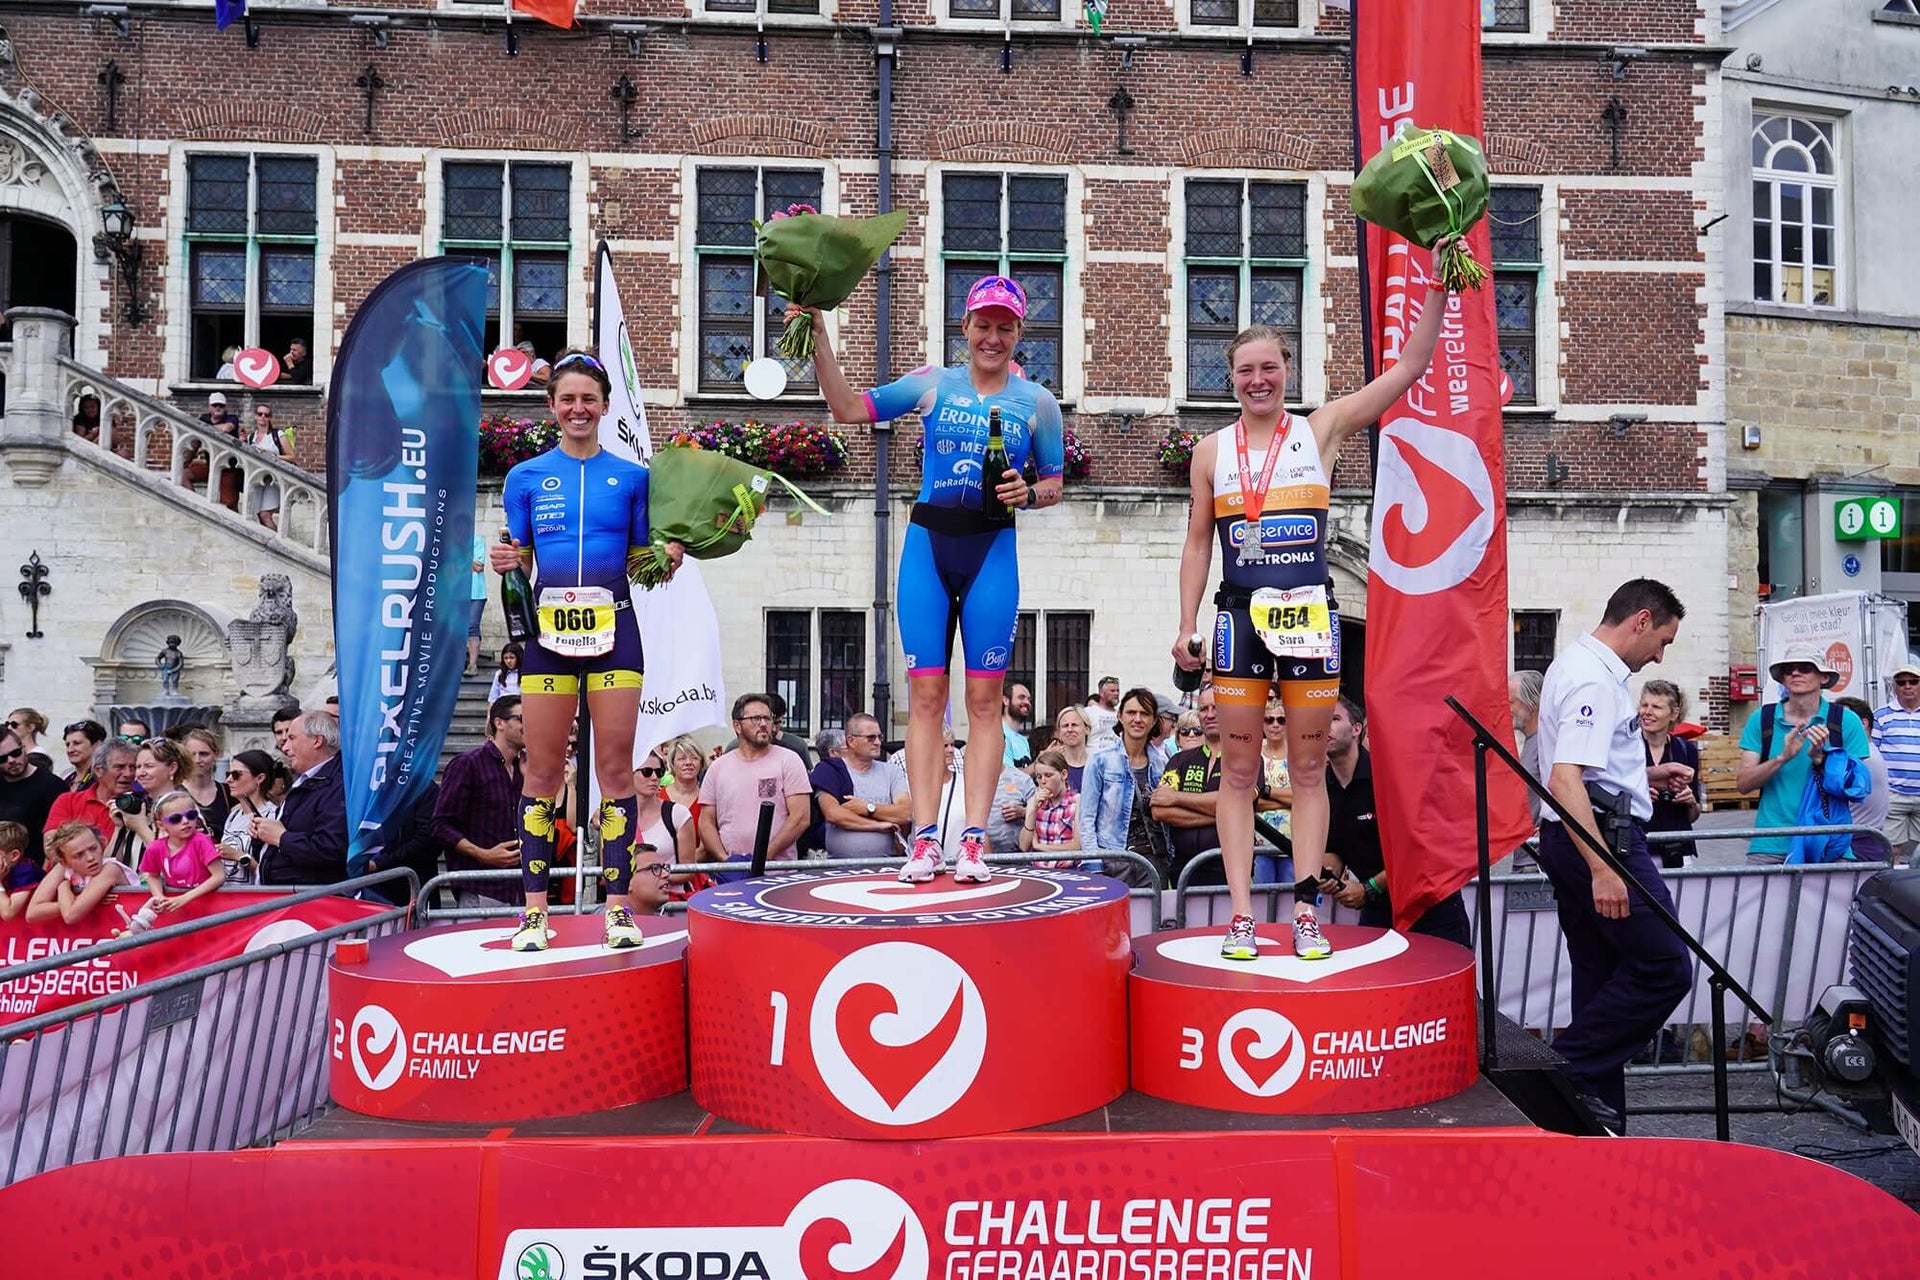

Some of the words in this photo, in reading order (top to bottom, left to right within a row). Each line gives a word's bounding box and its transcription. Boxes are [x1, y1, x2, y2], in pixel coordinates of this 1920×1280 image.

[935, 425, 1020, 447] ALKOHOLREI
[938, 407, 1022, 439] ERDINER
[423, 488, 447, 622] PRODUCTIONS
[554, 608, 596, 631] 060
[1268, 606, 1309, 629] 054
[1278, 635, 1305, 646] Sara
[417, 631, 433, 688] MOVIE
[639, 683, 718, 715] .skoda.b
[397, 695, 425, 786] CREATIVE
[745, 872, 820, 887] THE
[824, 864, 1092, 883] CHAONSHIP
[915, 896, 1101, 924] SLOVAKIA
[0, 994, 39, 1014] hlon!
[334, 1017, 345, 1061] 2
[412, 1027, 567, 1055] CHALLENGE
[769, 990, 789, 1067] 1
[1312, 1017, 1447, 1055] CHALLENGE
[1179, 1026, 1205, 1070] 3
[408, 1058, 481, 1080] FAMILY
[1309, 1056, 1384, 1081] FAMILY
[944, 1198, 1272, 1246] CHALLENGE
[583, 1245, 772, 1280] ŠKODA
[945, 1247, 1313, 1280] GERAARDSBERGEN
